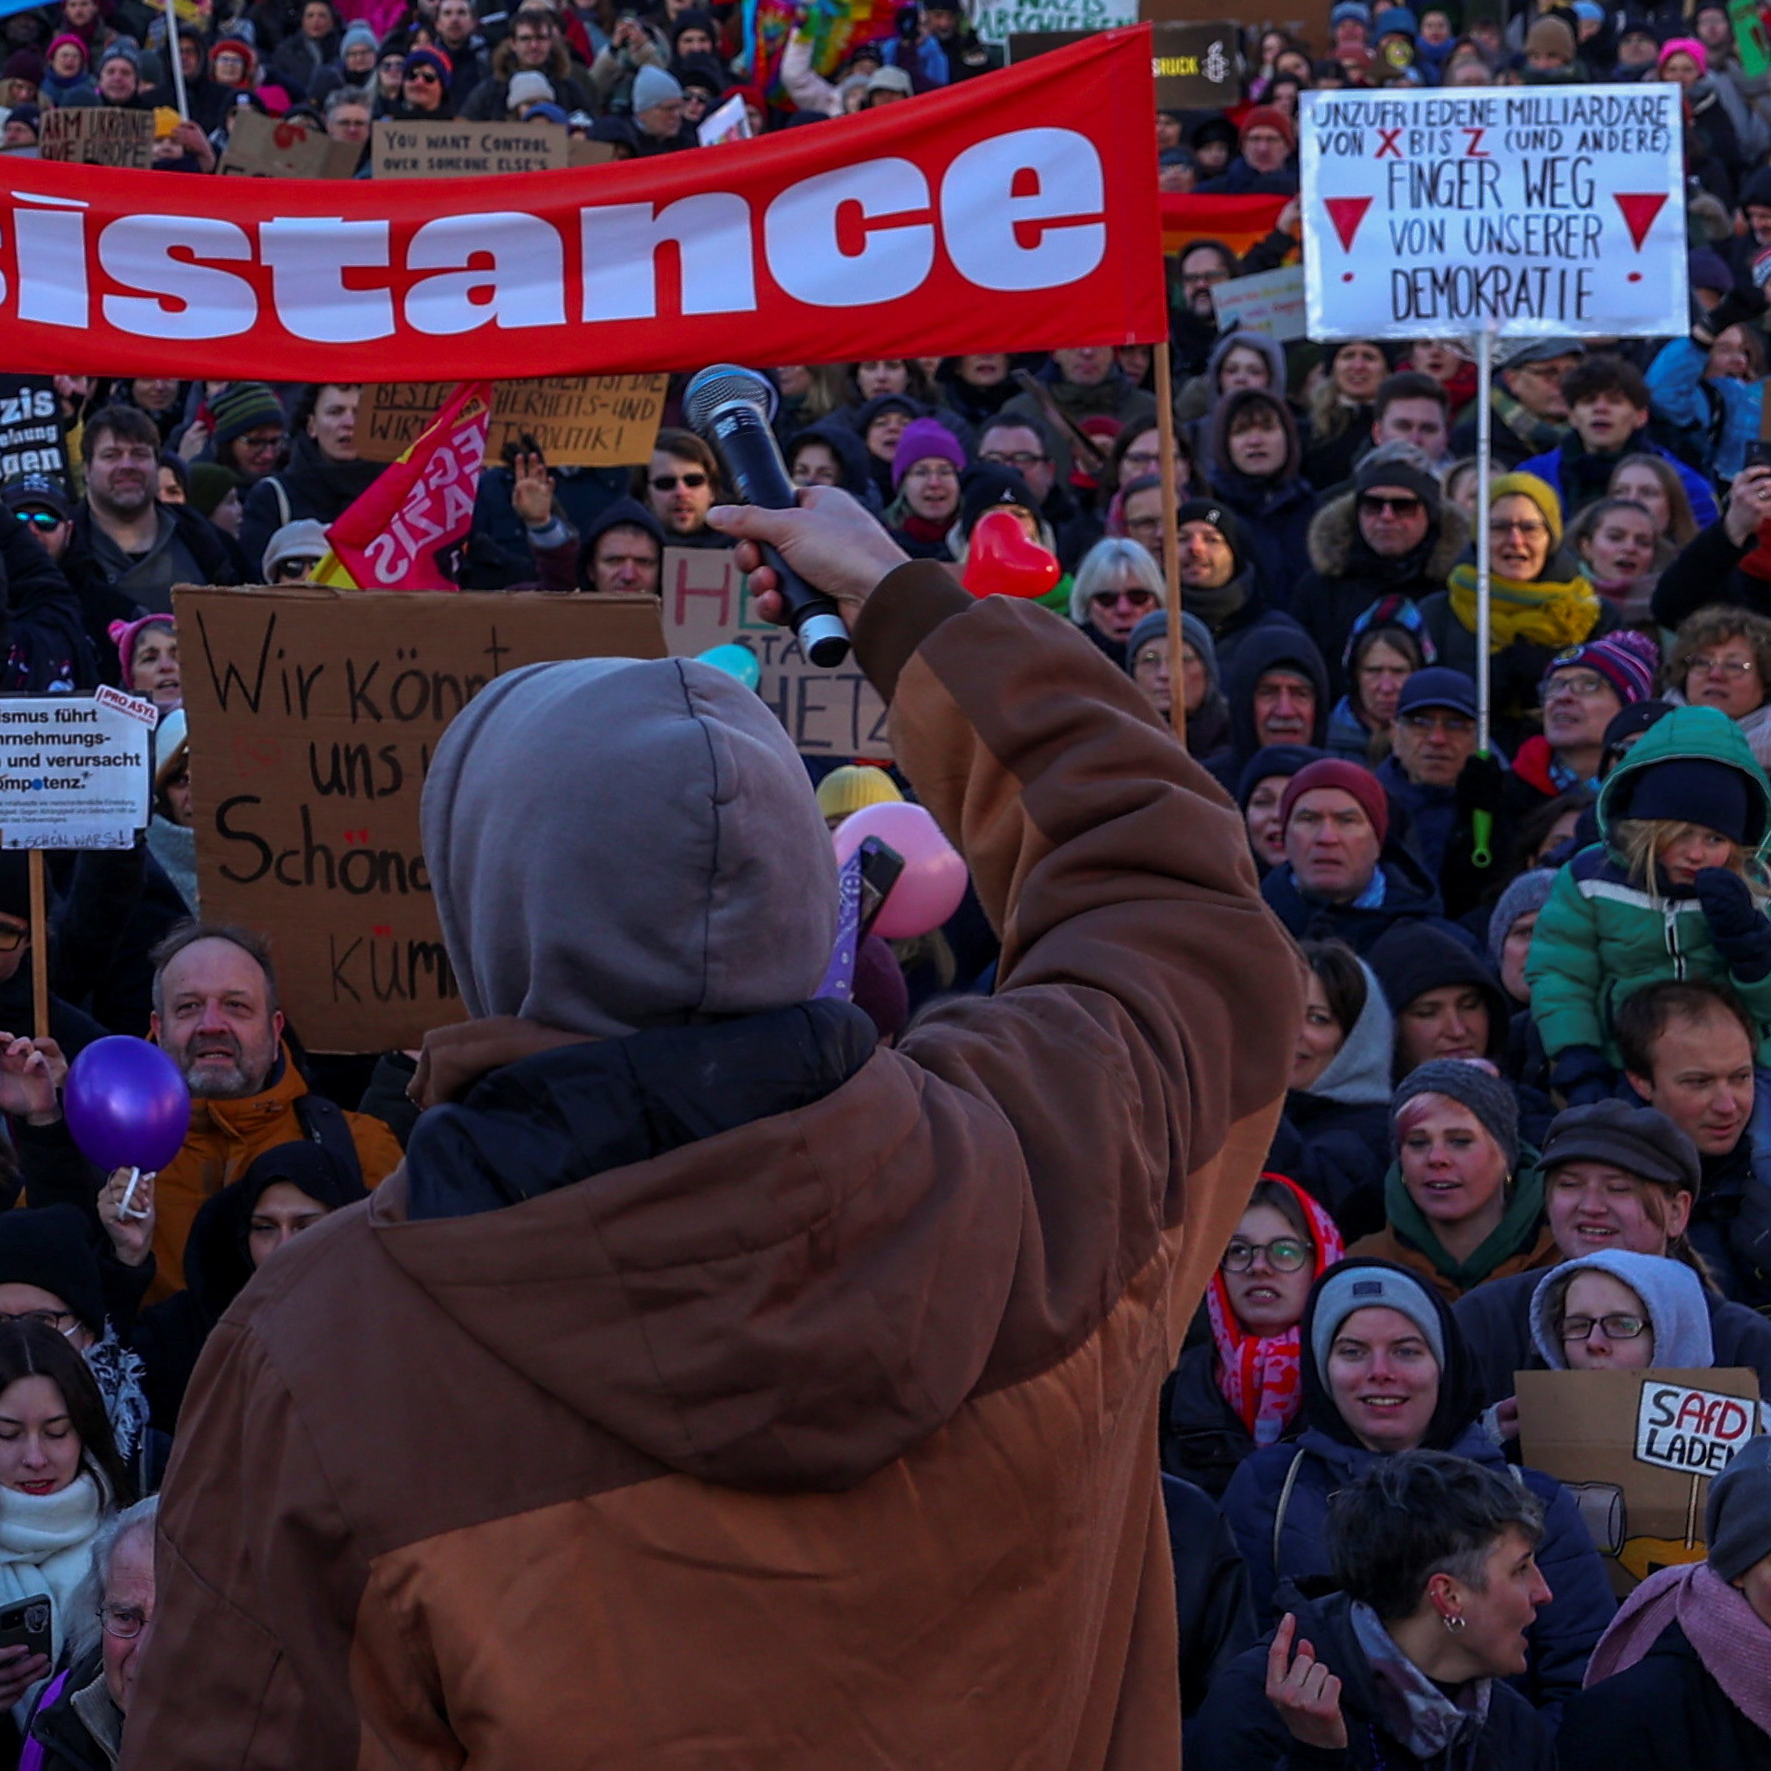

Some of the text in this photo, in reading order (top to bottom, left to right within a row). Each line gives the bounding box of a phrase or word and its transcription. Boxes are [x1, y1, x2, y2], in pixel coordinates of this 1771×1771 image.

[1311, 98, 1497, 129] UNZUFRIEDENE
[425, 132, 472, 153] WANT
[1318, 128, 1673, 158] VON X BIS Z (UND ANDERE)
[1387, 156, 1596, 211] FINGER WEG
[1388, 213, 1603, 261] VON UNSERER
[1391, 266, 1594, 323] DEMOKRATIE
[194, 608, 325, 717] Wir
[54, 708, 98, 724] führt
[102, 688, 128, 707] PRO
[7, 753, 40, 768] und
[46, 752, 142, 768] verursacht
[308, 738, 405, 800] uns
[1648, 1388, 1749, 1440] SAfD
